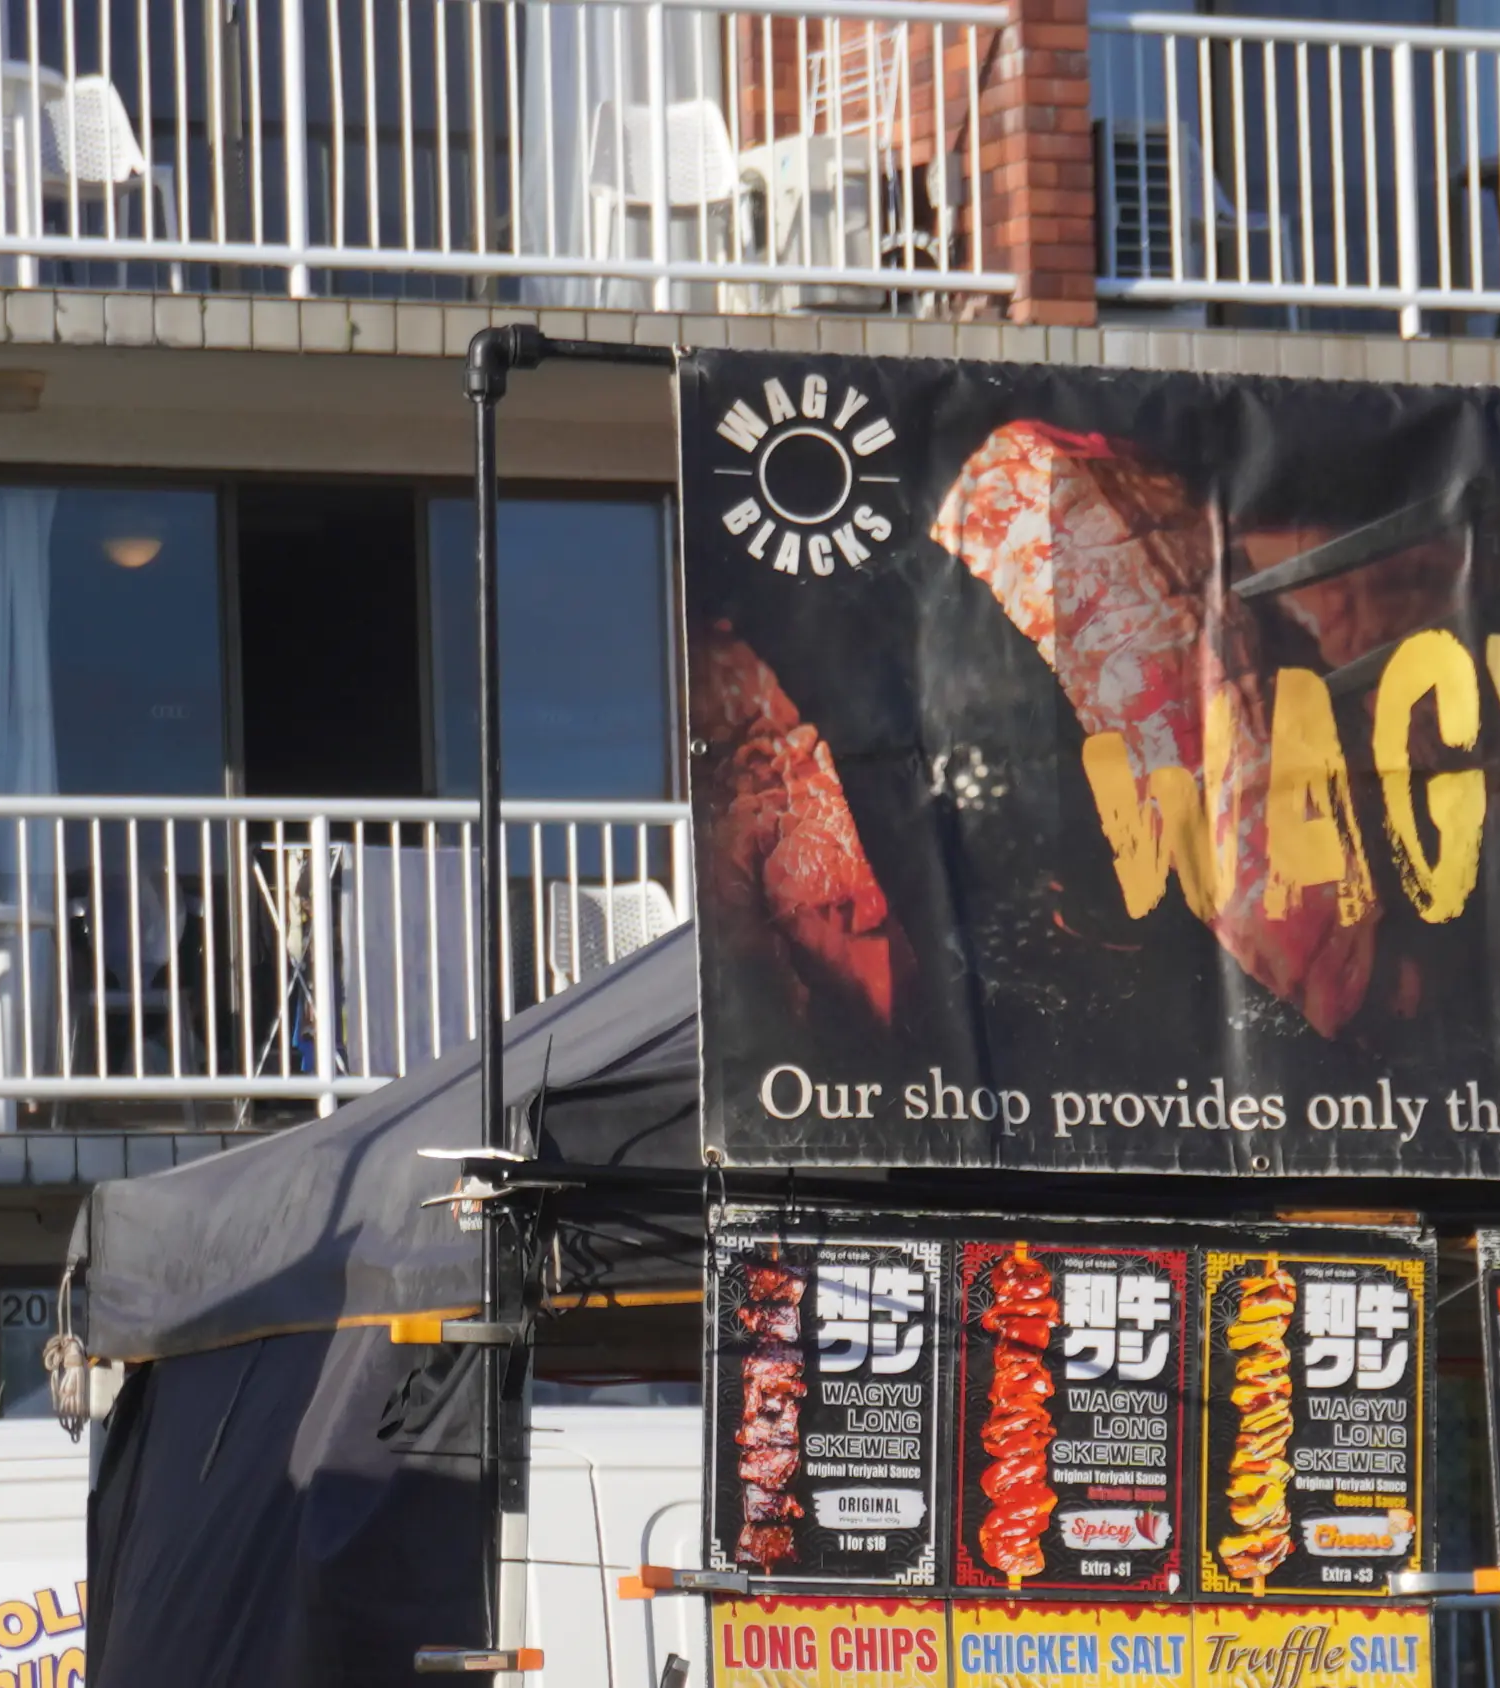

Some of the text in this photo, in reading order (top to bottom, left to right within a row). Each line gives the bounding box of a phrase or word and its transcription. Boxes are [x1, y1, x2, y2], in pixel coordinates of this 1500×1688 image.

[716, 374, 896, 457] WAGYU
[721, 498, 892, 576] BLACKS
[760, 1063, 882, 1121] Our
[904, 1067, 1031, 1134] shop
[1053, 1078, 1287, 1138] provides
[1307, 1078, 1429, 1142] only
[817, 1265, 924, 1322] 和牛
[1064, 1273, 1171, 1330] 和牛
[3, 1293, 47, 1328] 20
[1304, 1283, 1409, 1338] 和牛
[819, 1320, 924, 1374] クシ
[1065, 1328, 1170, 1380] クシ
[1305, 1337, 1408, 1389] クシ
[822, 1382, 921, 1407] WAGYU
[1068, 1389, 1167, 1414] WAGYU
[848, 1409, 921, 1433] LONG
[1309, 1397, 1406, 1421] WAGYU
[1094, 1416, 1167, 1440] LONG
[1334, 1424, 1406, 1448] LONG
[805, 1434, 921, 1459] SKEWER
[1052, 1441, 1166, 1466] SKEWER
[807, 1462, 921, 1479] Original Teriyaki Sauce
[1294, 1450, 1405, 1473] SKEWER
[1054, 1468, 1166, 1485] Original Teriyaki Sauce
[1296, 1476, 1406, 1492] Original Teriyaki Sauce
[838, 1496, 901, 1514] ORIGINAL
[1335, 1494, 1406, 1508] Cheese Sauce
[839, 1535, 844, 1550] 1
[847, 1535, 864, 1551] for
[1070, 1517, 1135, 1546] Spicy
[1313, 1524, 1395, 1551] Cheese
[1081, 1560, 1112, 1576] Extra
[1322, 1566, 1352, 1582] Extra
[723, 1623, 938, 1674] LONG CHIPS
[961, 1633, 1185, 1676] CHICKEN SALT
[1350, 1635, 1419, 1674] SALT
